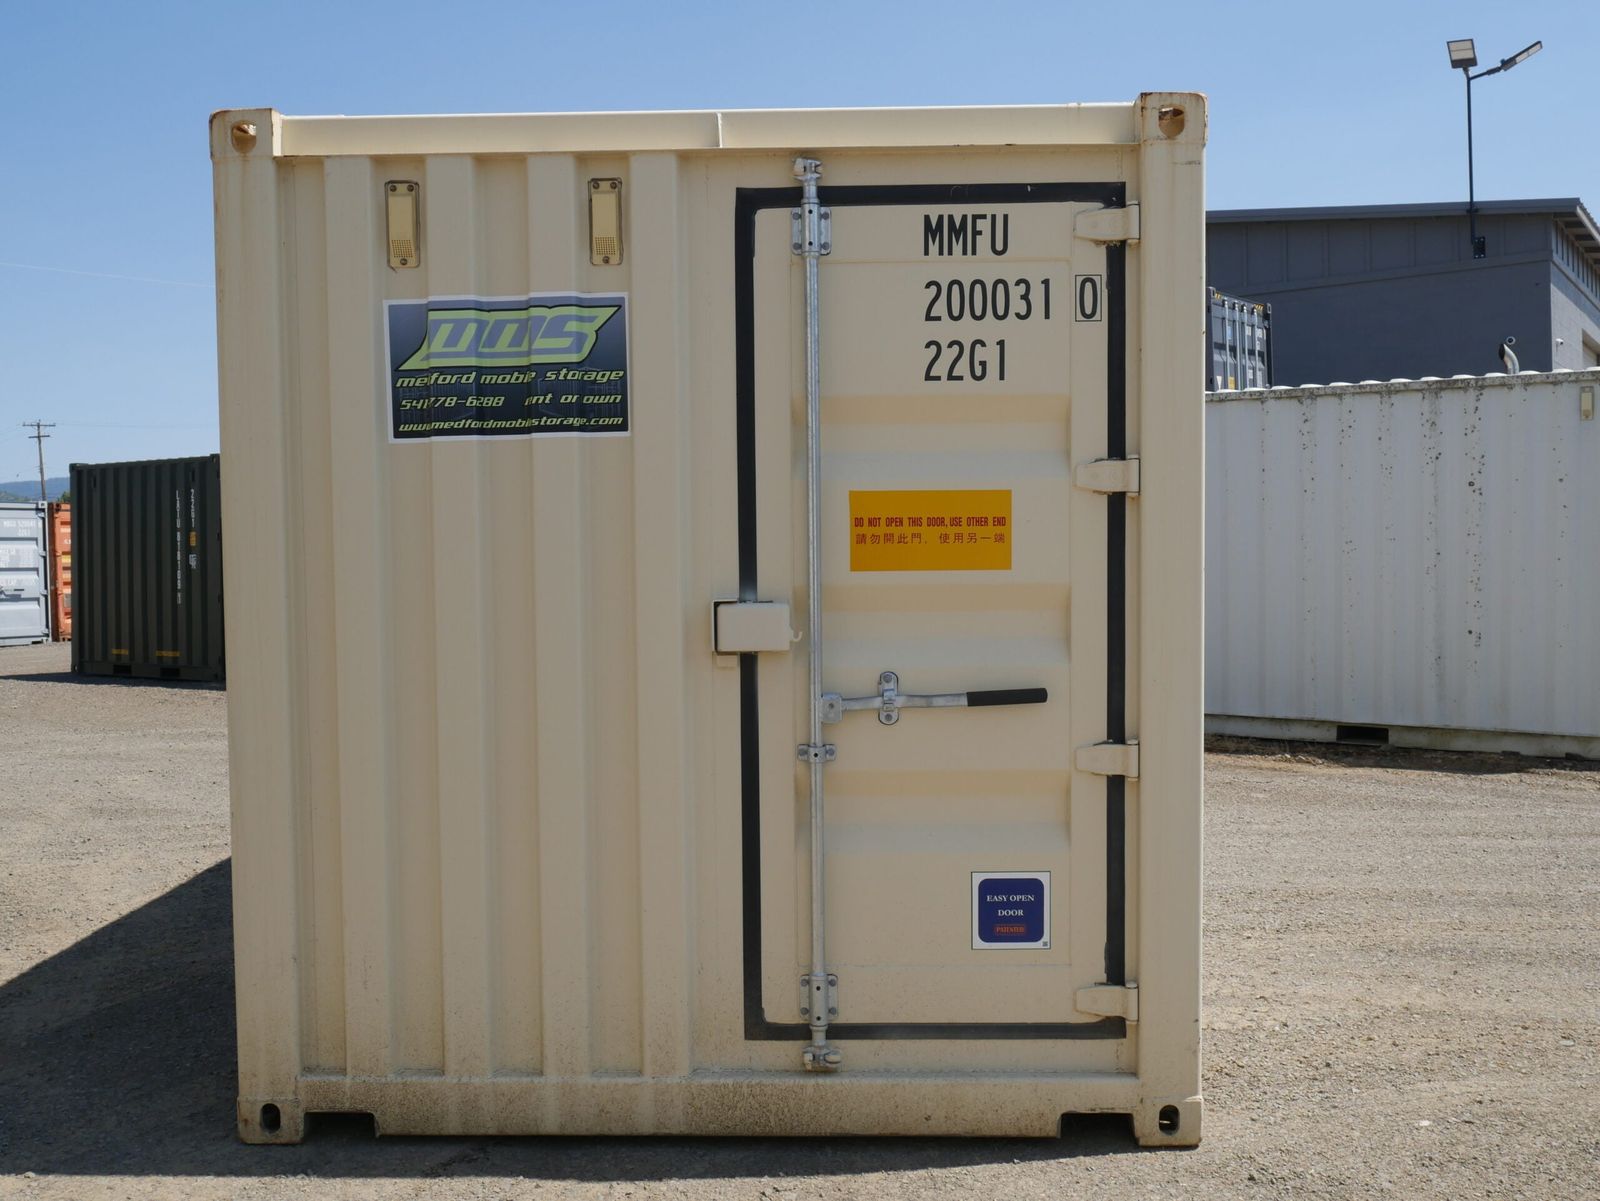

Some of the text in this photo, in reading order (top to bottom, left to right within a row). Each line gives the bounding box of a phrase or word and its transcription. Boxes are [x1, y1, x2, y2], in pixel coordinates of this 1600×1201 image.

[923, 213, 1009, 256] MMFU
[924, 276, 1099, 322] 200031 0
[924, 338, 1005, 381] 22G1
[545, 368, 625, 383] storage
[559, 393, 578, 404] or
[582, 393, 622, 405] own
[854, 516, 864, 527] DO
[867, 516, 881, 527] NOT
[885, 516, 903, 527] OPEN
[908, 516, 923, 527] THIS
[966, 516, 989, 527] OTHER
[992, 516, 1006, 527] END
[986, 894, 1035, 902] EASY OPEN
[997, 909, 1024, 917] DOOR
